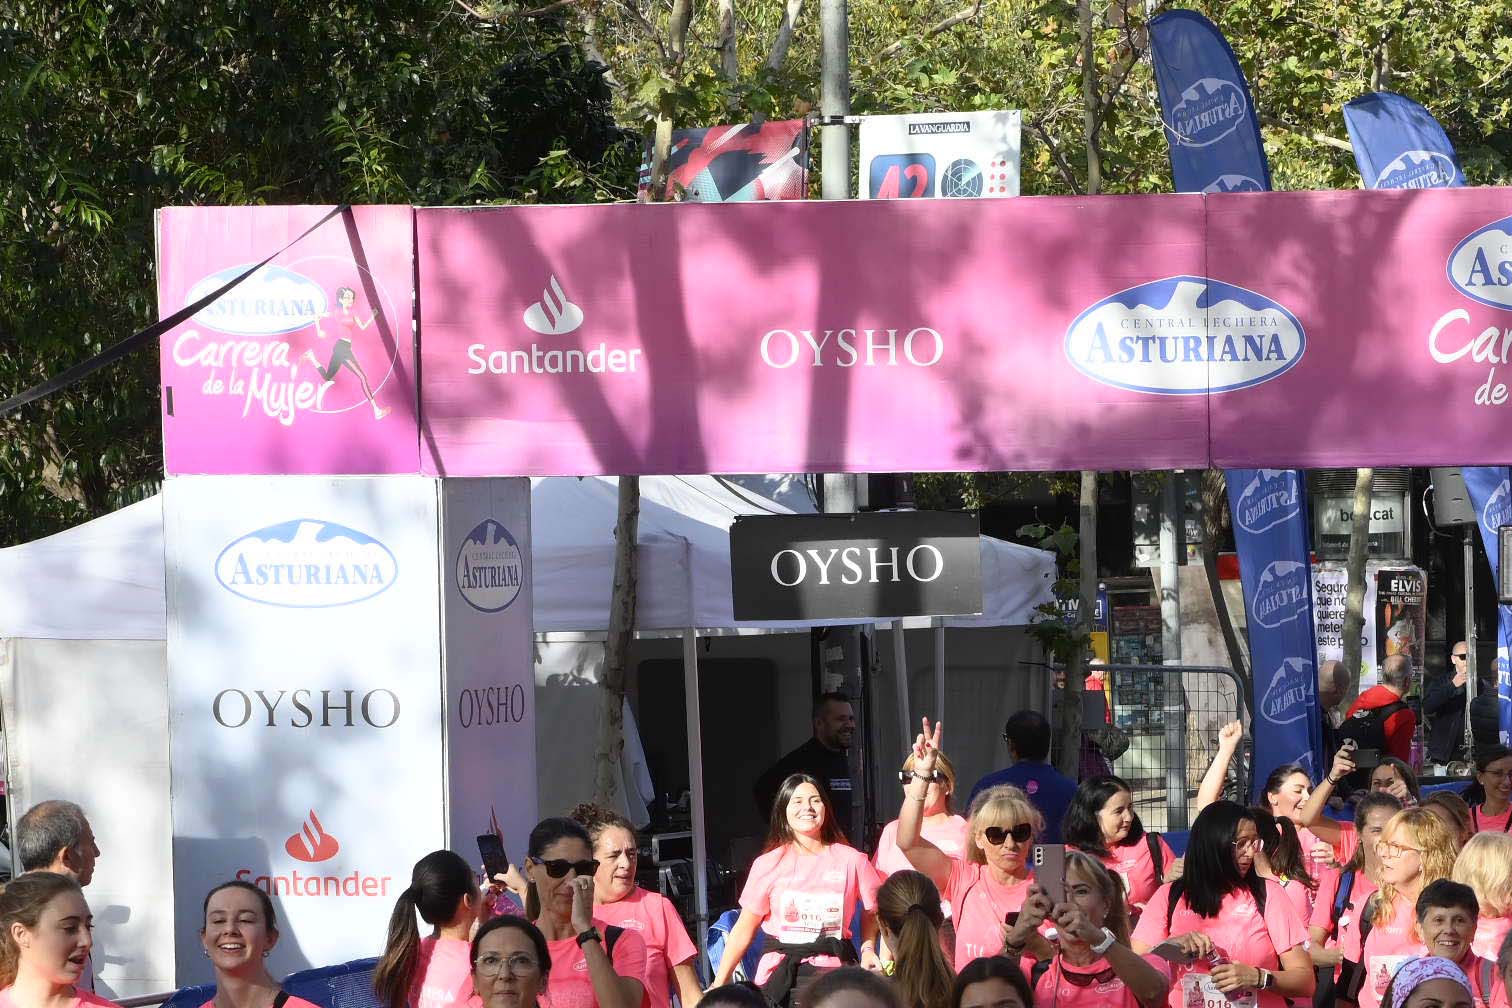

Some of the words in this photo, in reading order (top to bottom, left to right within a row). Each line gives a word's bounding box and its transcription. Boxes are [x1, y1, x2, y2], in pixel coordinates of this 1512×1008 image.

[1120, 316, 1196, 330] CENTRAL
[1202, 315, 1279, 329] LECHERA
[172, 330, 290, 367] Carrera
[467, 343, 641, 375] Santander
[760, 327, 944, 368] OYSHO
[1087, 322, 1286, 364] ASTURIANA
[202, 373, 223, 395] de
[229, 369, 245, 395] la
[242, 365, 335, 426] Mujer
[1473, 370, 1509, 407] de
[229, 553, 384, 586] ASTURIANA
[461, 558, 520, 590] ASTURIANA
[770, 544, 944, 587] OYSHO
[1391, 580, 1421, 592] ELVIS
[1316, 597, 1331, 611] que
[1317, 635, 1337, 646] este
[211, 688, 401, 729] OYSHO
[458, 683, 525, 729] OYSHO
[1207, 999, 1232, 1008] 016
